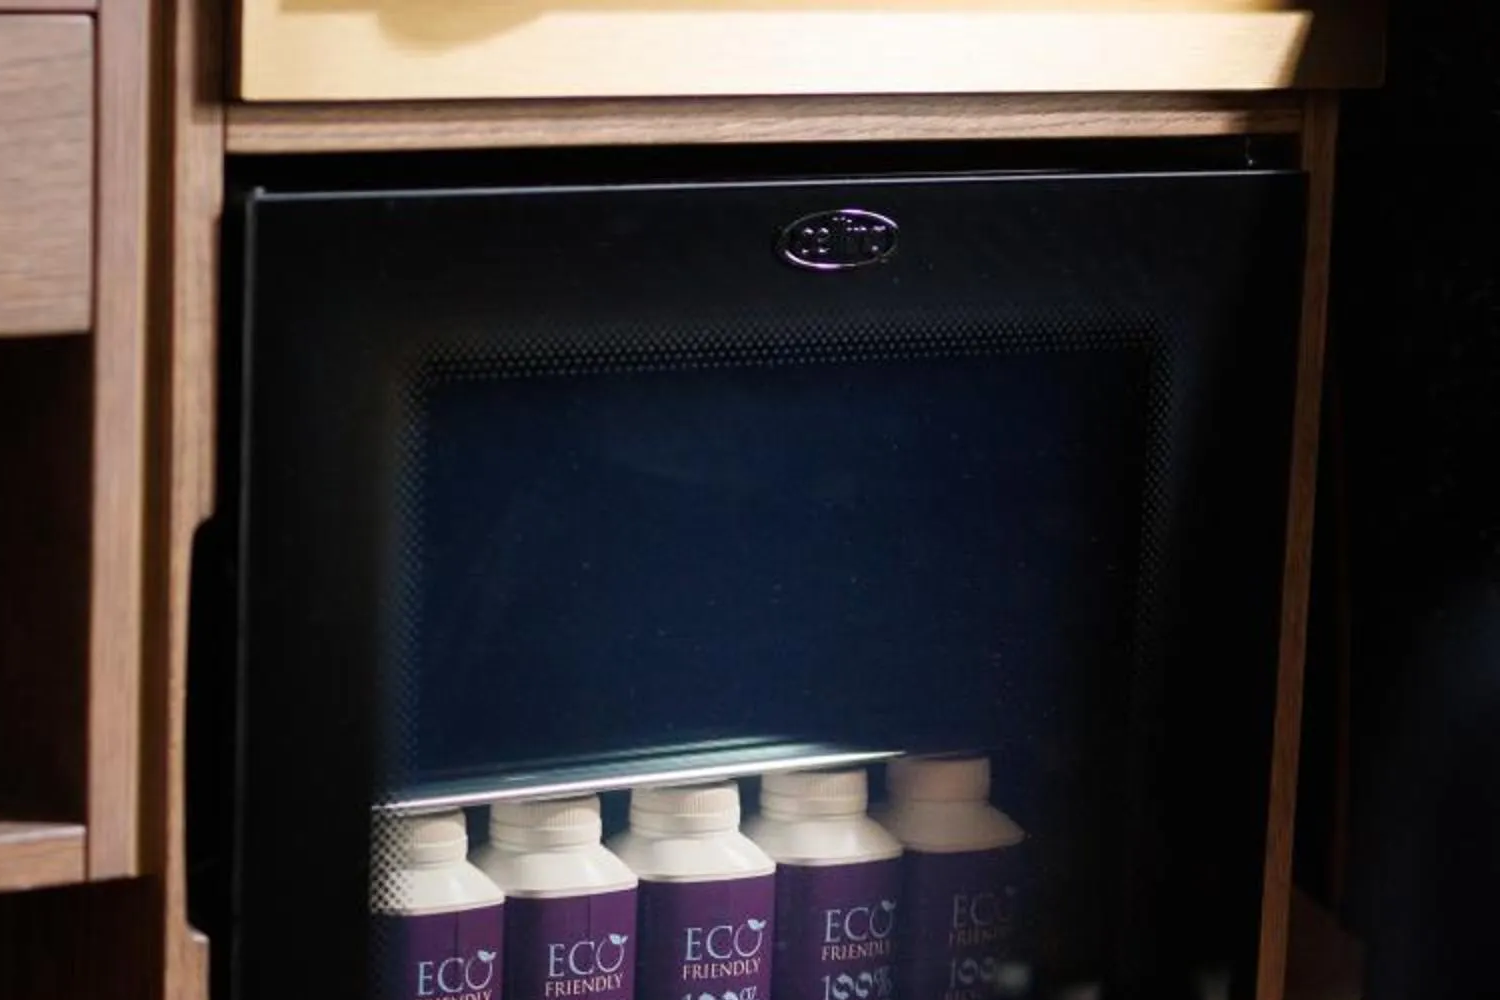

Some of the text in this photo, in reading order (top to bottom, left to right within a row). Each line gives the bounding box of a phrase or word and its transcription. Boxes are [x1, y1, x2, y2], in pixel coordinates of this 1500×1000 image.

[683, 919, 765, 962] ECO
[824, 900, 896, 943] ECO
[417, 951, 496, 996] ECO
[548, 935, 627, 978] ECO
[682, 957, 762, 981] FRIENDLY
[545, 973, 624, 998] FRIENDLY
